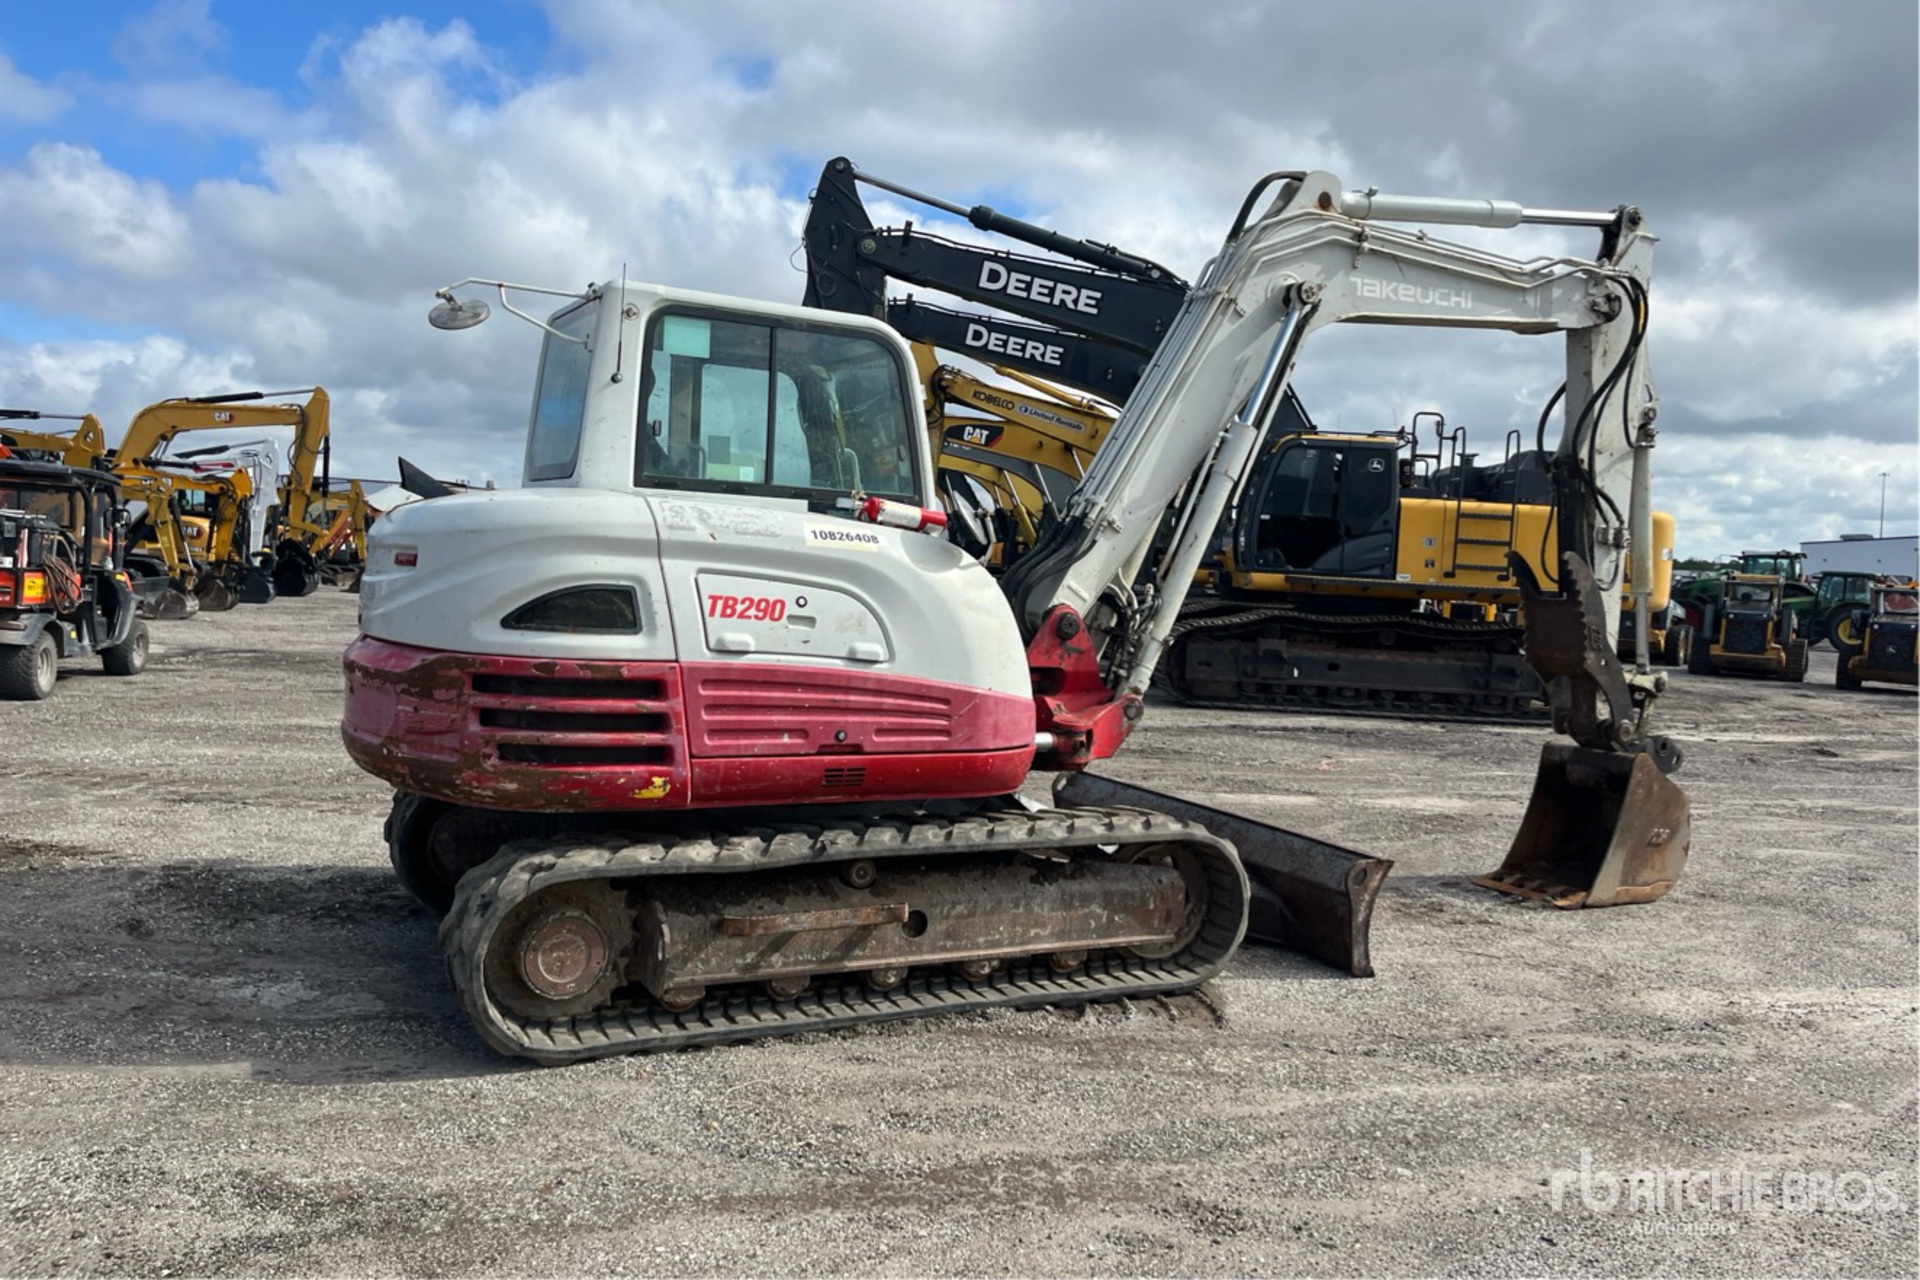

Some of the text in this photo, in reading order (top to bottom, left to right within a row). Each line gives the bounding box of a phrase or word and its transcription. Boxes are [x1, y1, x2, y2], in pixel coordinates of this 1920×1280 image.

[979, 260, 1102, 315] DEERE
[965, 323, 1064, 366] DEERE
[972, 389, 1015, 411] KOBELCO
[1029, 408, 1082, 431] United Rentals
[963, 425, 989, 445] CAT
[810, 529, 879, 545] 10826408
[707, 594, 786, 622] TB290
